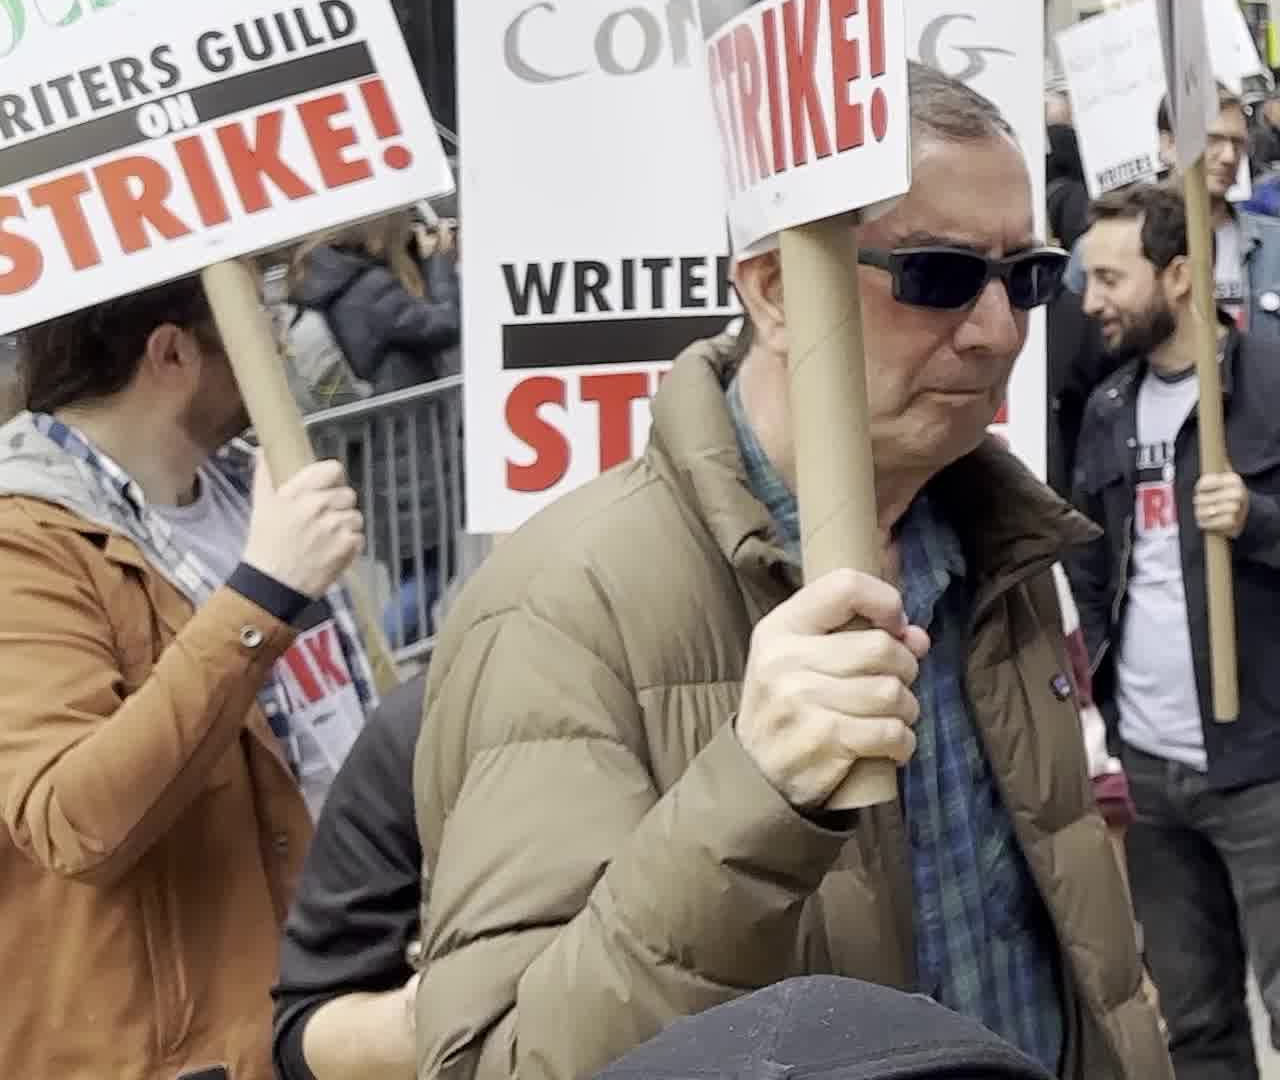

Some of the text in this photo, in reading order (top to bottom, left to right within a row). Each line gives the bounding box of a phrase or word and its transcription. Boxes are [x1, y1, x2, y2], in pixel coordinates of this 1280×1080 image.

[196, 0, 357, 74] GUILD
[137, 93, 200, 139] ON
[0, 78, 413, 297] STRIKE!
